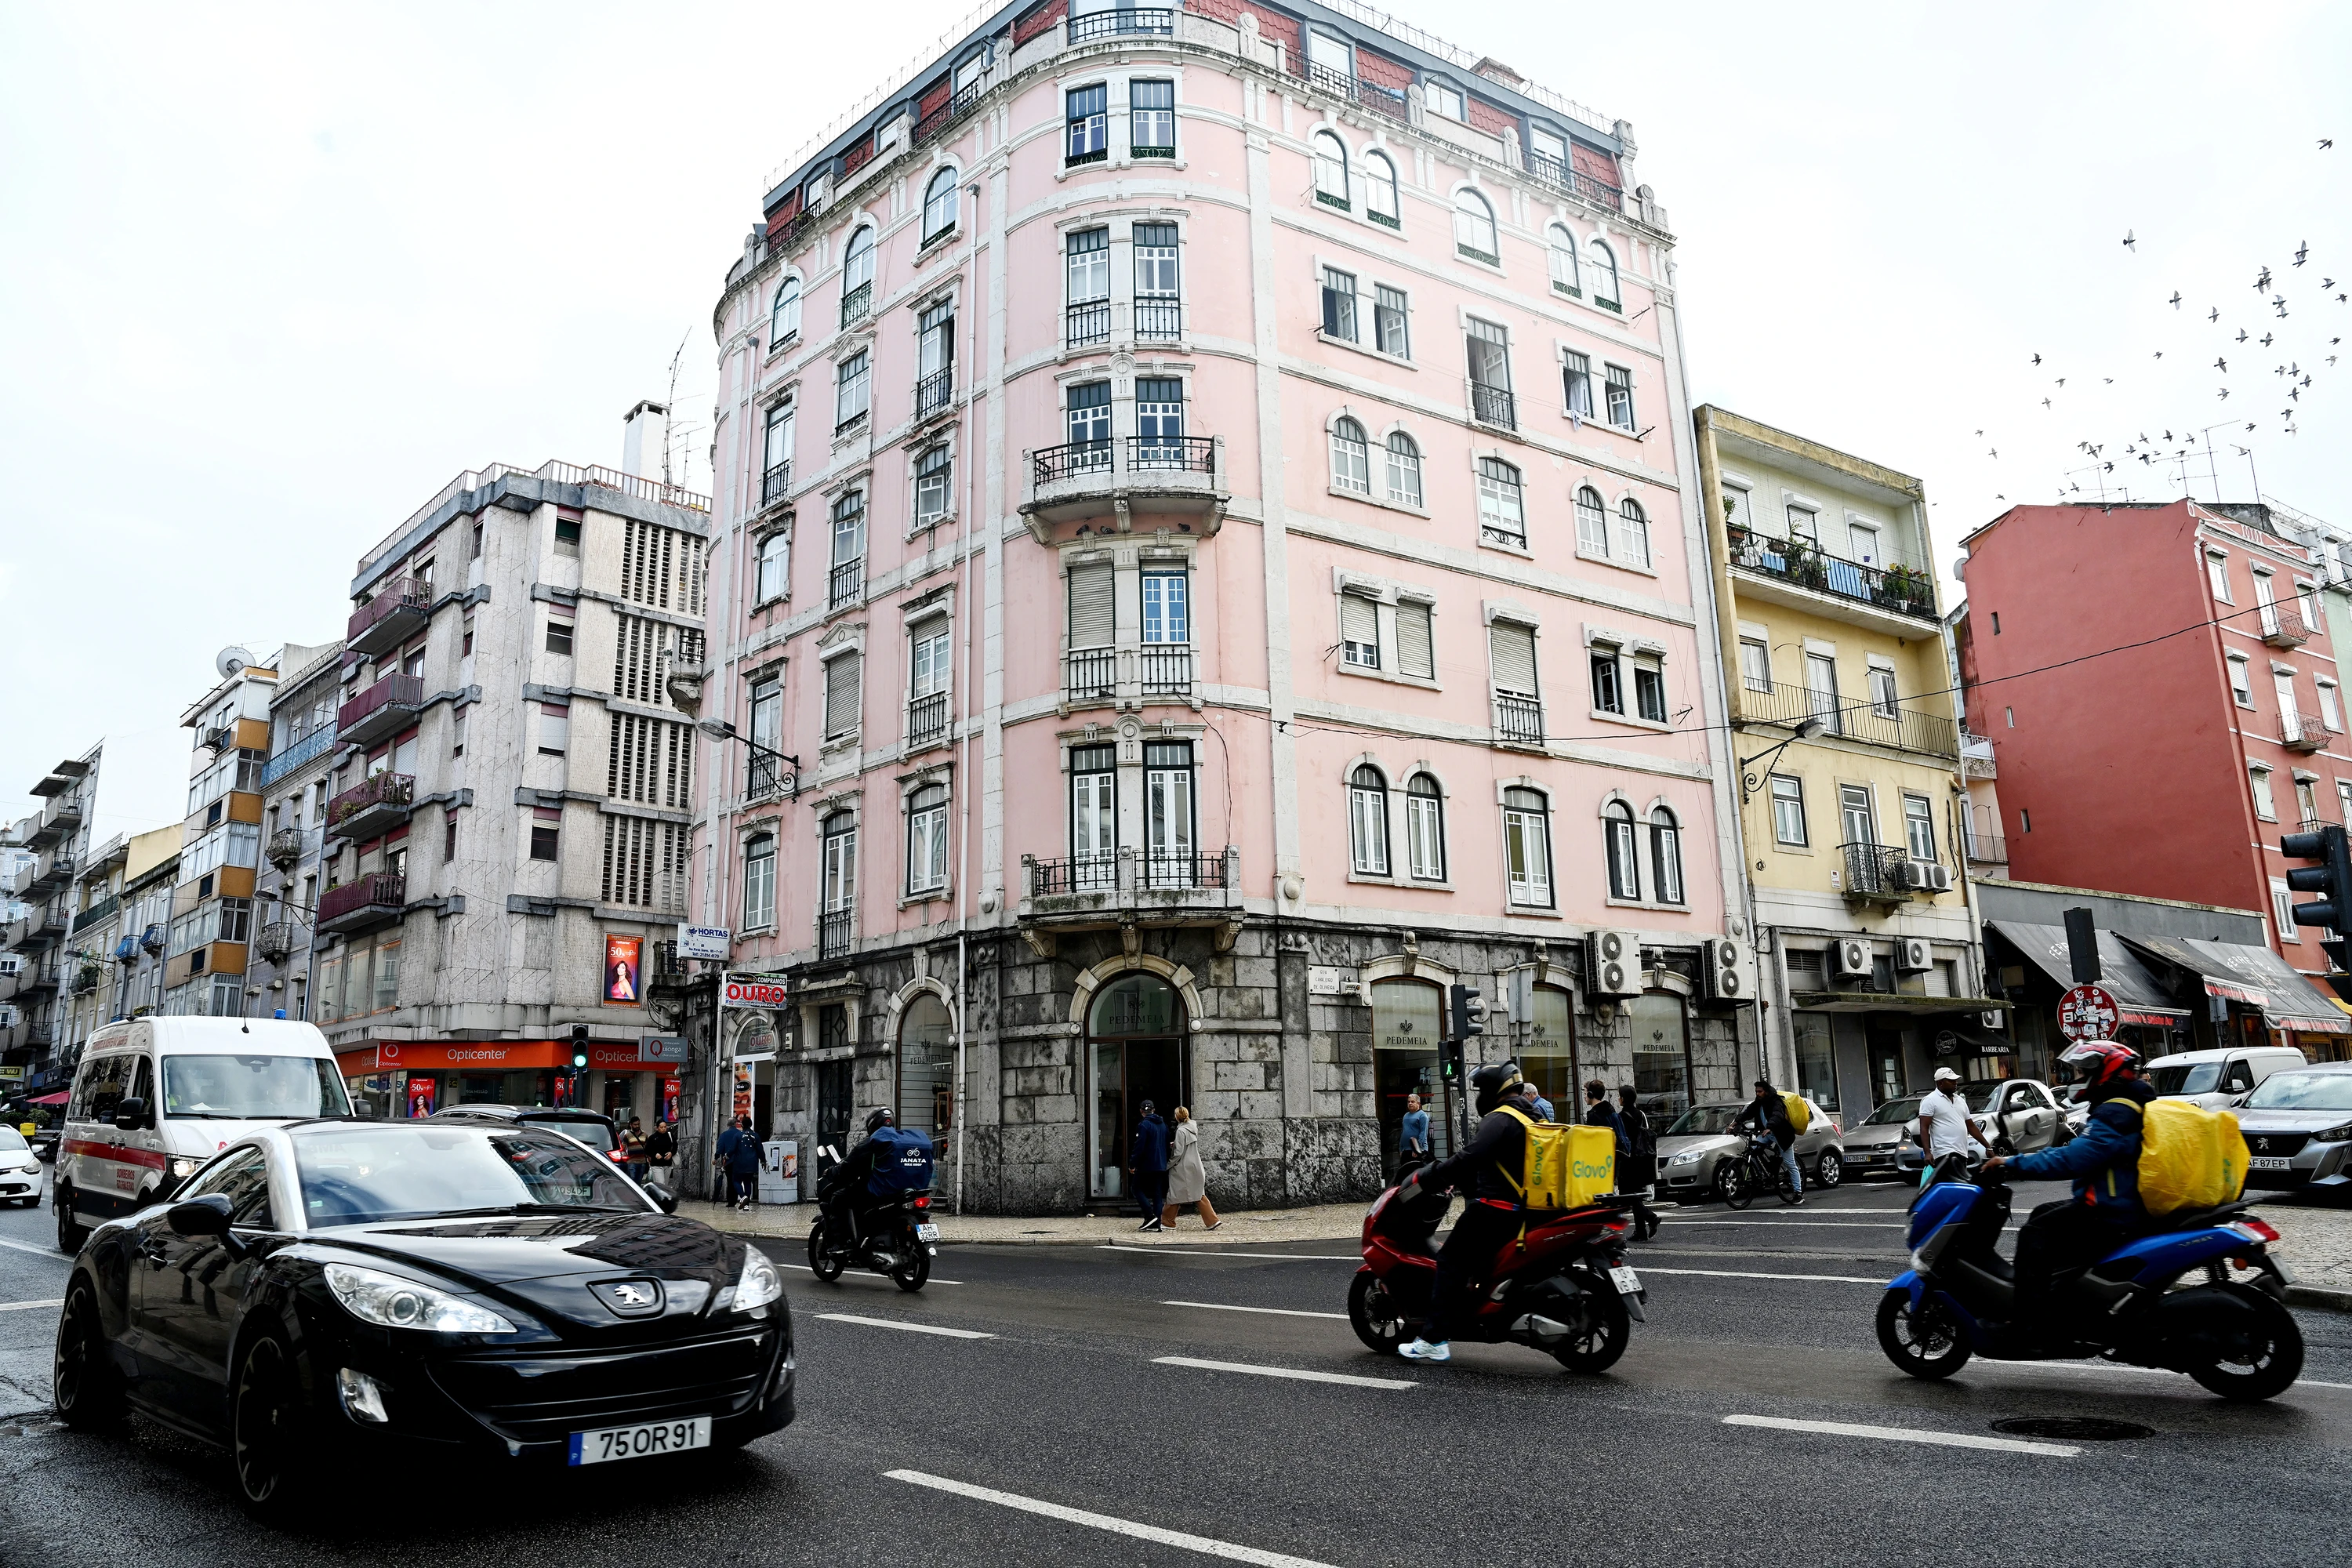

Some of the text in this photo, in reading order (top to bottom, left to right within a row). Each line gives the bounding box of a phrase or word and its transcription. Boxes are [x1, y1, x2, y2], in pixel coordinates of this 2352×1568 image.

[698, 928, 728, 938] HORTAS
[757, 976, 786, 985] COMPRAMOS
[727, 983, 785, 1004] OURO
[1109, 1014, 1165, 1025] PEDEMEIA
[750, 1034, 772, 1047] OURO
[1386, 1036, 1428, 1045] PEDEMEIA
[1531, 1039, 1559, 1047] DEMEIA
[447, 1048, 506, 1062] Opticenter
[650, 1040, 681, 1058] Quionga
[595, 1050, 638, 1064] Opticen
[910, 1054, 942, 1065] PEDEMEIA
[1532, 1146, 1544, 1186] Glovo
[1572, 1160, 1607, 1178] Glovo
[920, 1231, 938, 1240] 32RR
